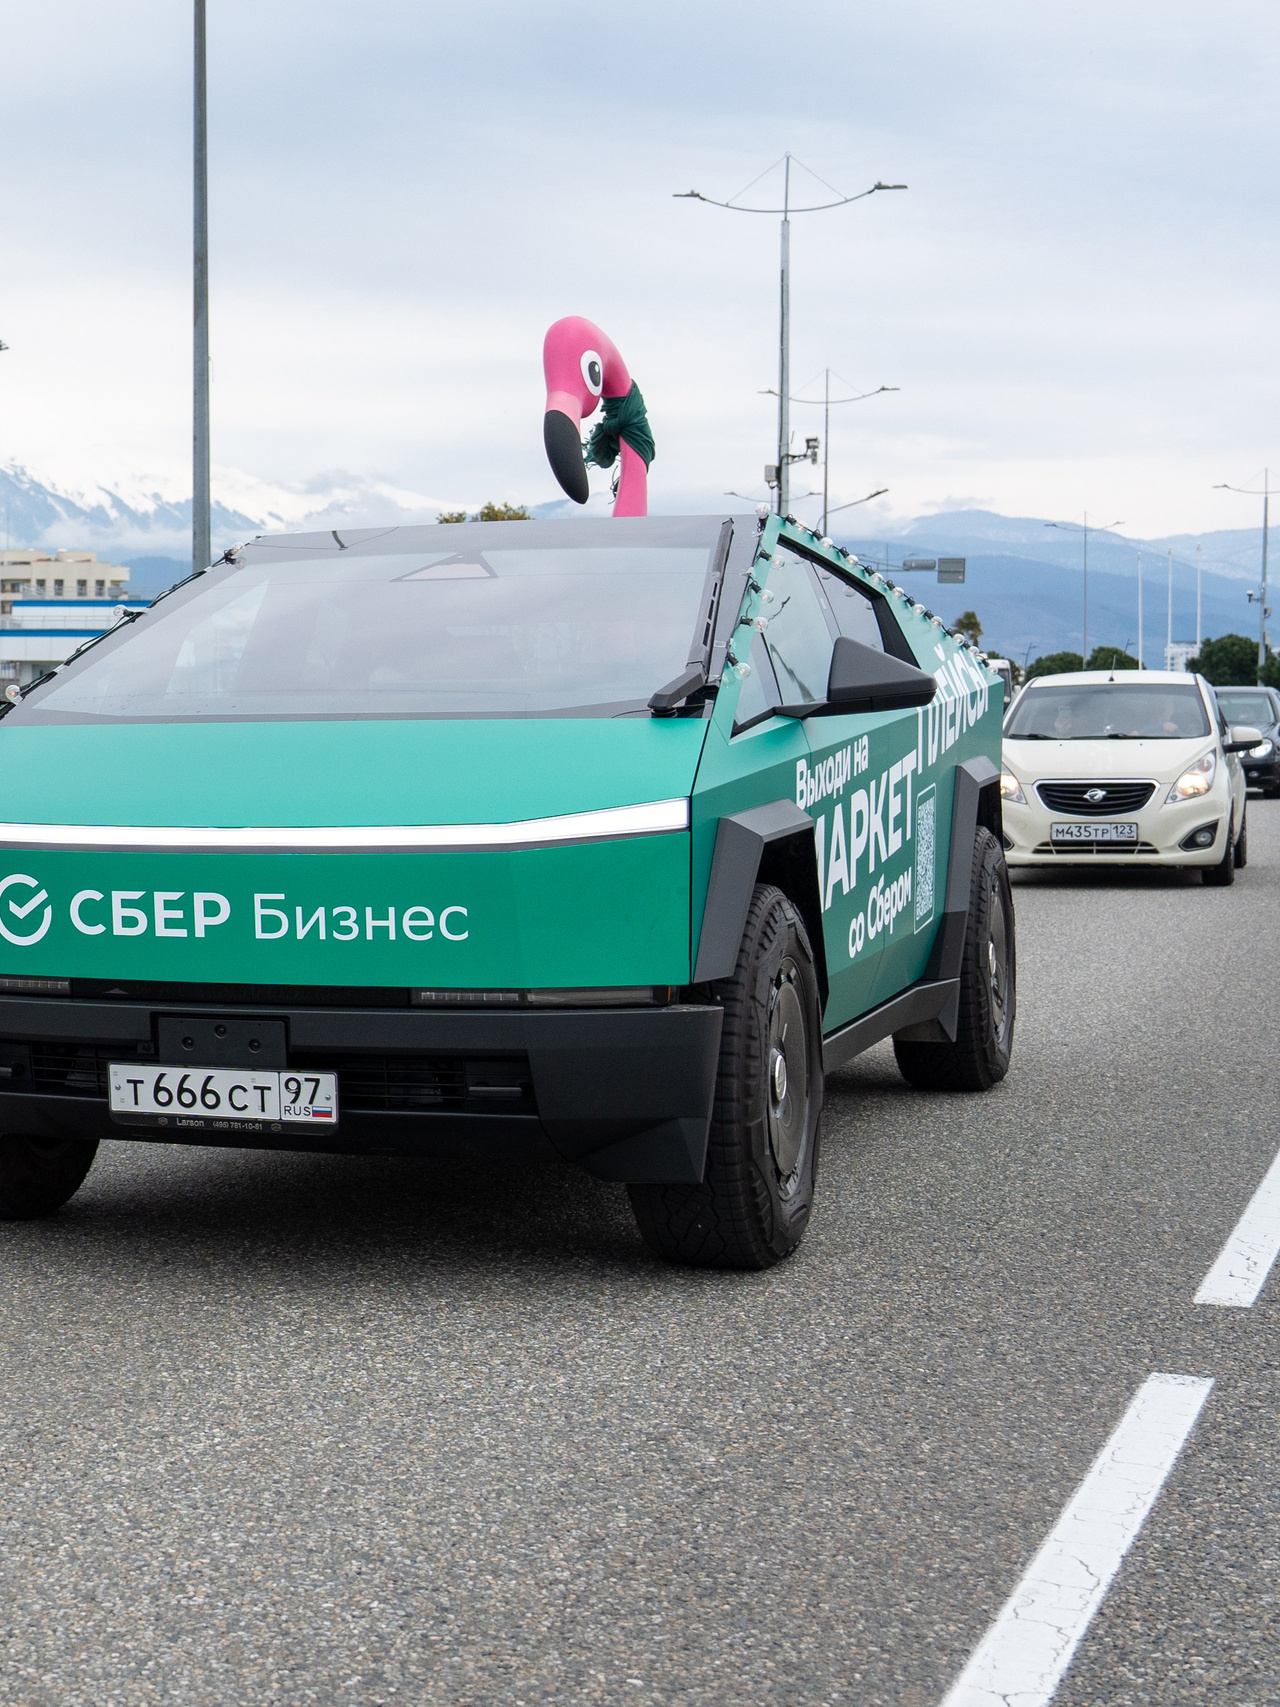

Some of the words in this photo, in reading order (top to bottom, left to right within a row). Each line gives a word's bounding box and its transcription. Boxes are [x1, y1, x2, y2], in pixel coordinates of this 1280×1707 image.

[796, 744, 851, 811] Выходи
[853, 734, 869, 777] на
[1055, 825, 1109, 838] М435ТР
[1112, 824, 1133, 835] 123
[69, 889, 231, 938] СБЕР
[253, 893, 469, 941] Бизнес
[848, 911, 864, 959] со
[867, 866, 912, 940] Сбером
[126, 1072, 272, 1113] Т666СТ
[284, 1076, 321, 1105] 97
[284, 1105, 311, 1117] RUS
[176, 1117, 205, 1127] Larson
[213, 1120, 229, 1130] (495)
